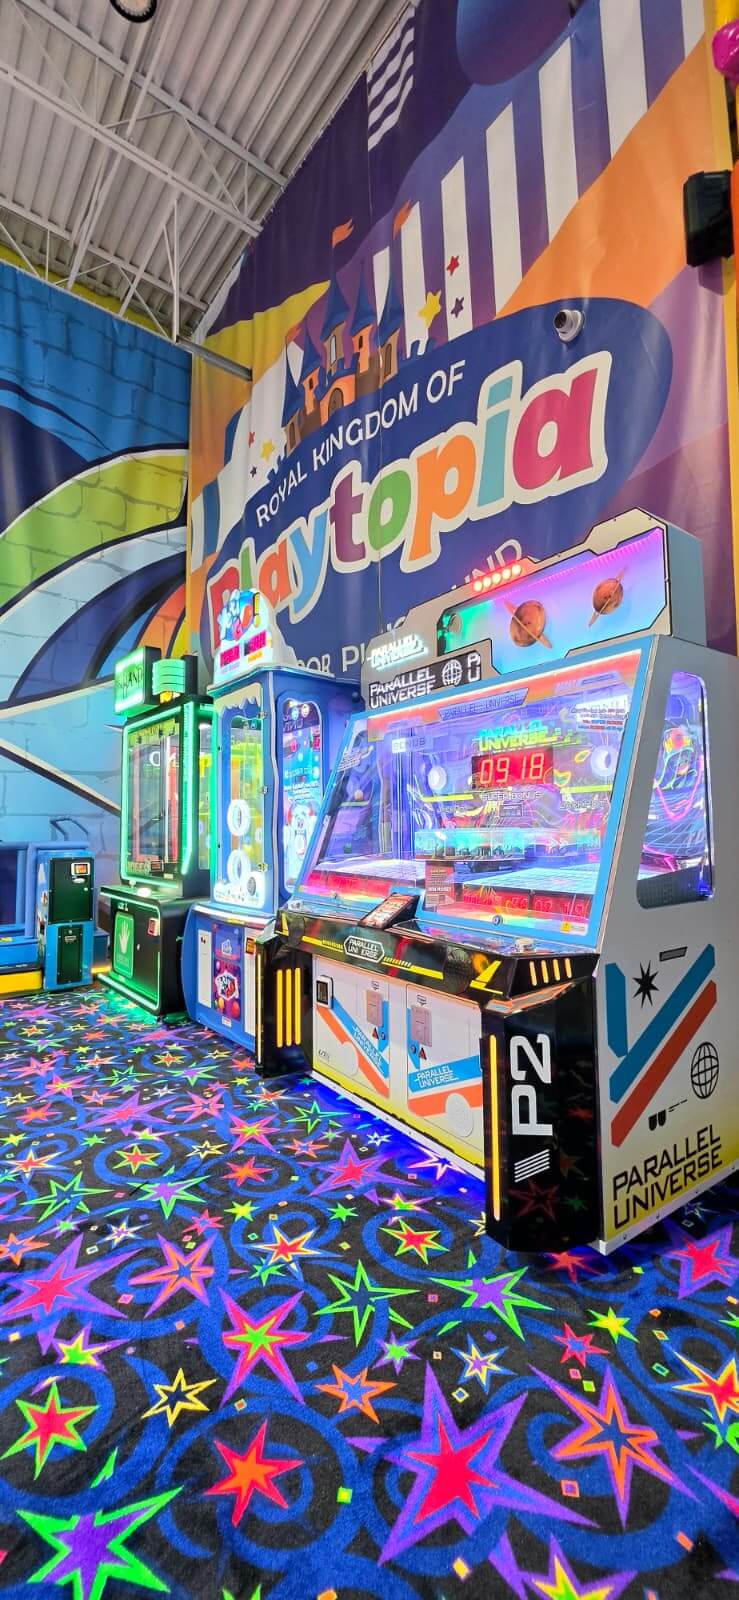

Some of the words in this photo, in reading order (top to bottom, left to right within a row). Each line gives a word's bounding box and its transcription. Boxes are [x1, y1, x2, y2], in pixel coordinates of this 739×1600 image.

[256, 470, 308, 528] ROYAL
[313, 386, 418, 466] KINGDOM
[426, 361, 466, 403] OF
[207, 351, 613, 652] Playtopia
[370, 667, 436, 697] PARALLEL
[370, 679, 436, 709] UNIVERSE
[477, 720, 544, 738] PARALLEL
[479, 729, 552, 752] UNIVERSE
[348, 940, 379, 952] PARALLEL
[415, 1064, 453, 1081] PARALLEL
[418, 1073, 456, 1089] UNIVERSE
[509, 1033, 554, 1137] P2
[612, 1124, 722, 1202] PARALLEL
[613, 1143, 723, 1230] UNIVERSE
